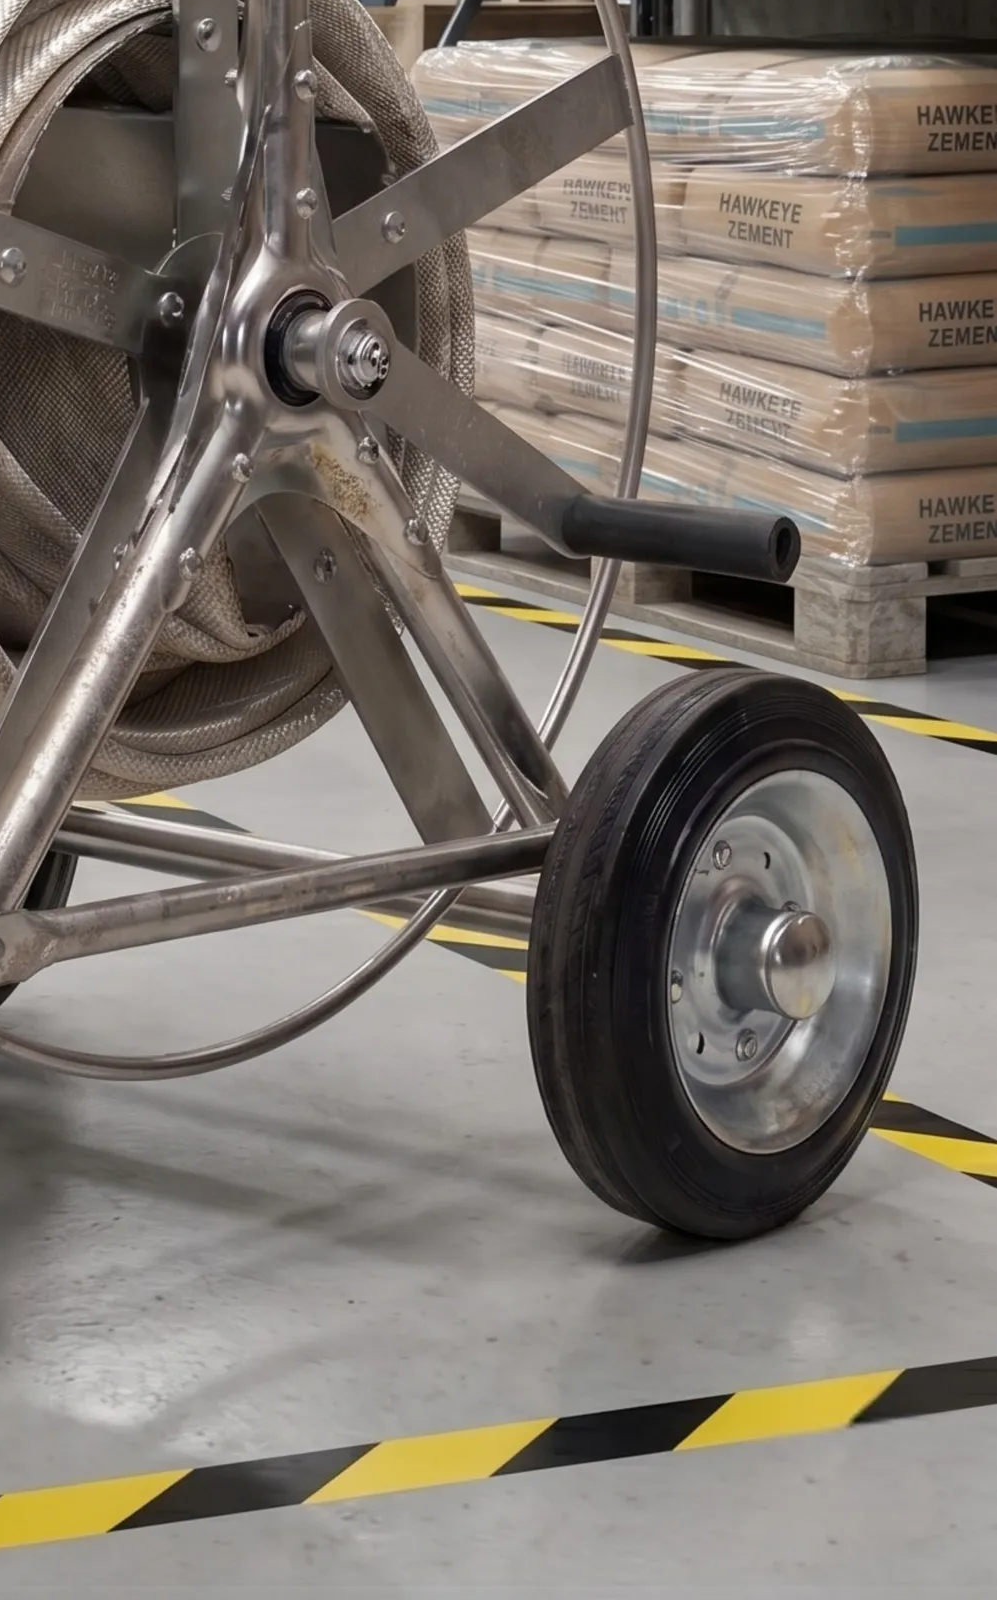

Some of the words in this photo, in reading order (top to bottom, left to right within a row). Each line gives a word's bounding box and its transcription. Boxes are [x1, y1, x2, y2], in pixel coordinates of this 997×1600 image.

[916, 104, 997, 126] HAWKE
[927, 131, 997, 152] ZEMEN
[719, 192, 803, 224] HAWKEYE
[727, 220, 794, 249] ZEMENT
[927, 326, 997, 348] ZEMEN
